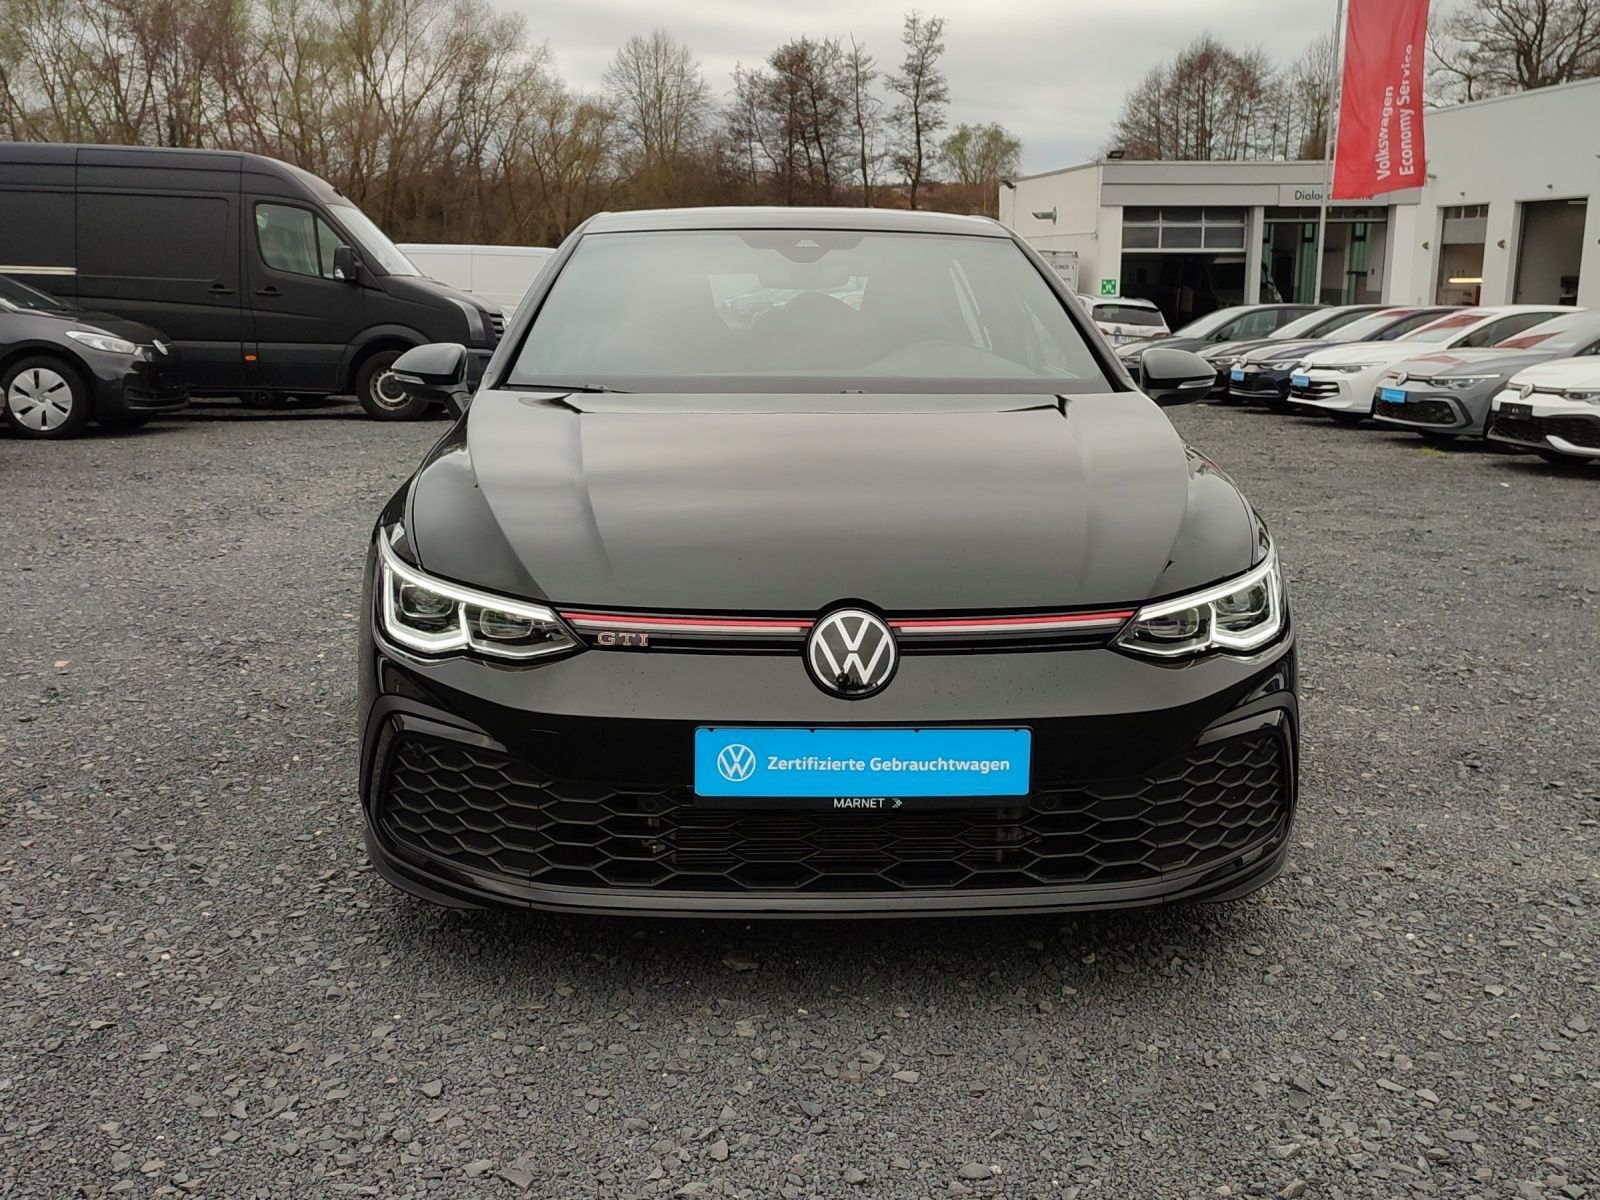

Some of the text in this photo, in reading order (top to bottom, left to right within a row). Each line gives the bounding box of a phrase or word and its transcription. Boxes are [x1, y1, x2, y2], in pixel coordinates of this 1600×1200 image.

[1397, 44, 1415, 176] Economy Service
[1375, 85, 1394, 180] Volkswagen
[597, 631, 649, 647] GTI
[767, 756, 1010, 774] Zertifizierte Gebrauchtwagen
[833, 798, 885, 809] MARNET
